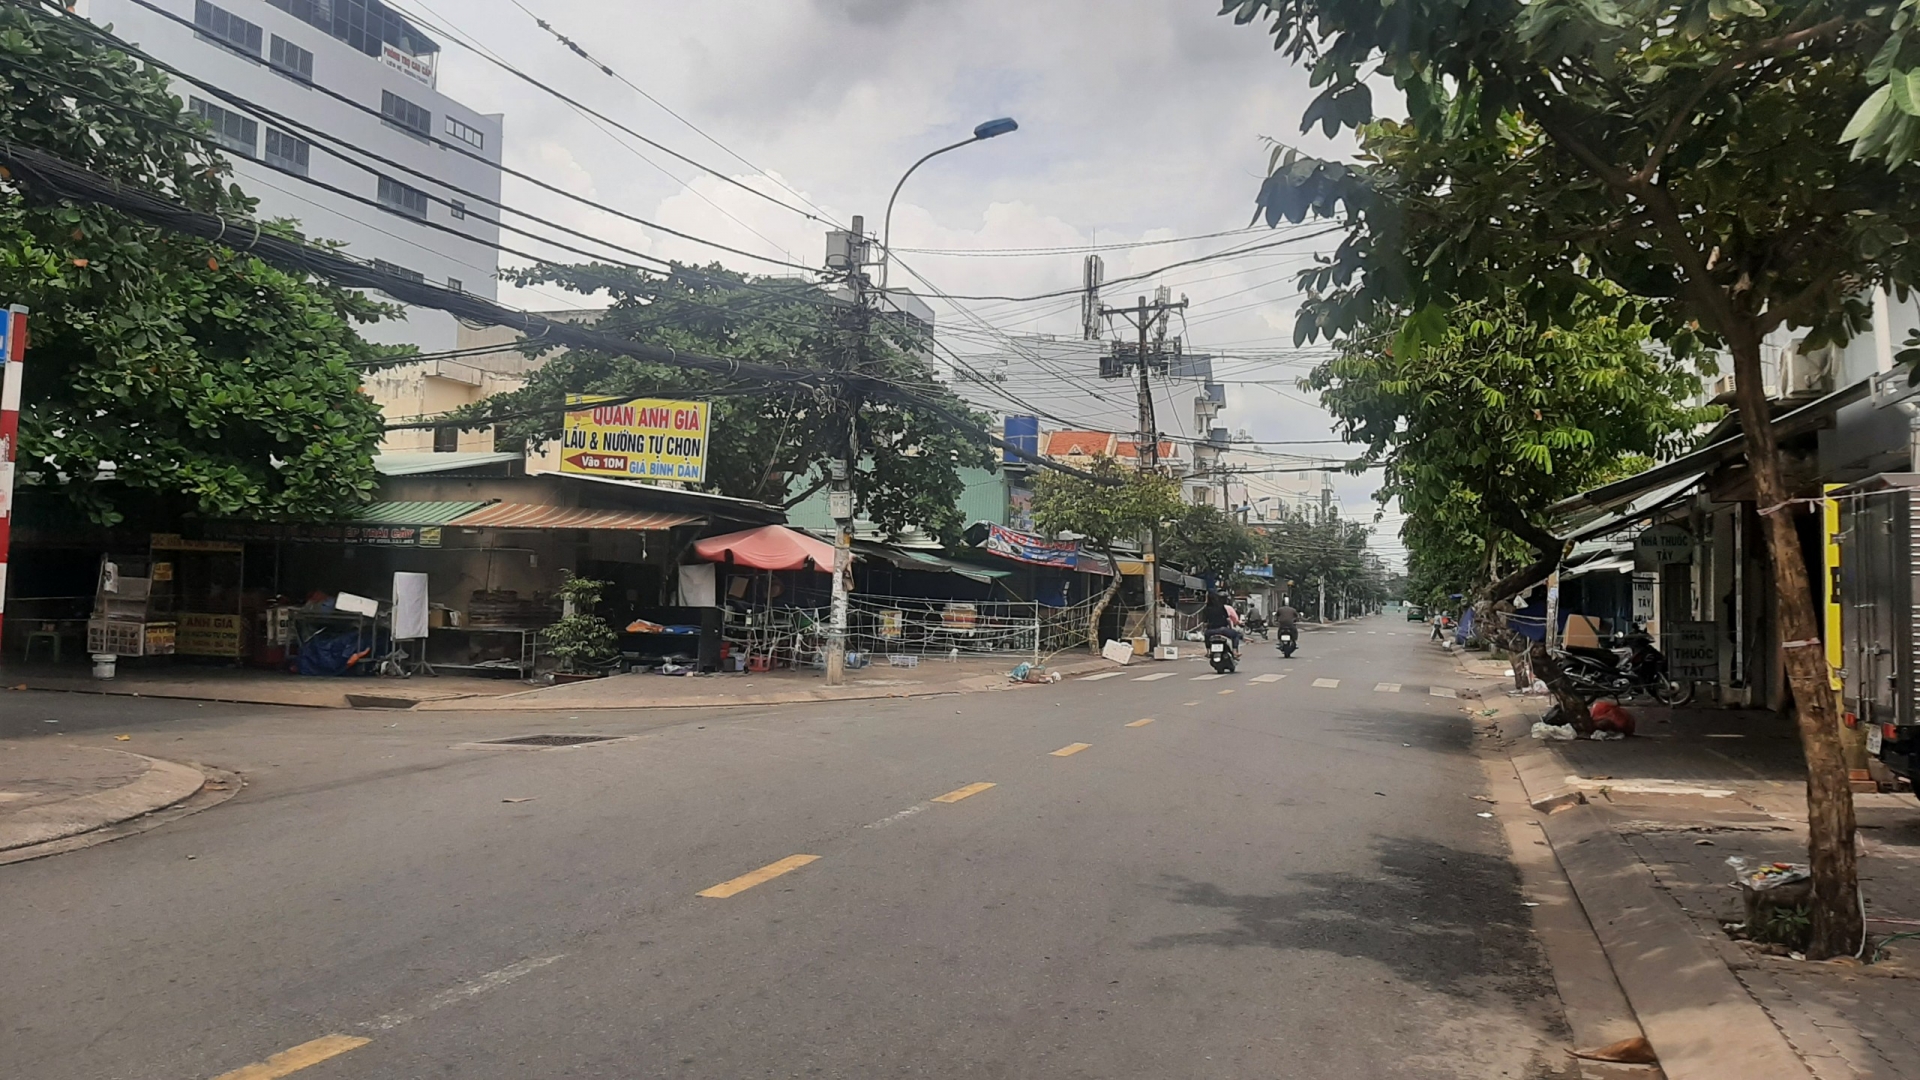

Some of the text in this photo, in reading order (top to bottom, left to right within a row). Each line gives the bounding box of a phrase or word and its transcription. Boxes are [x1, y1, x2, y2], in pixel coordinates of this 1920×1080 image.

[638, 408, 670, 429] ANH
[674, 405, 701, 430] GIÀ
[564, 423, 702, 461] LẨU & NƯỚNG TỰ CHỌN
[581, 456, 625, 469] Vào 10M
[629, 458, 700, 478] GIÁ BÌNH DÂN
[362, 525, 388, 538] TRÁI
[390, 526, 415, 539] CÂY
[1641, 535, 1657, 547] NHÀ
[1660, 532, 1688, 547] THUỐC
[1656, 549, 1674, 561] TÂY
[1674, 645, 1714, 659] THUỐC
